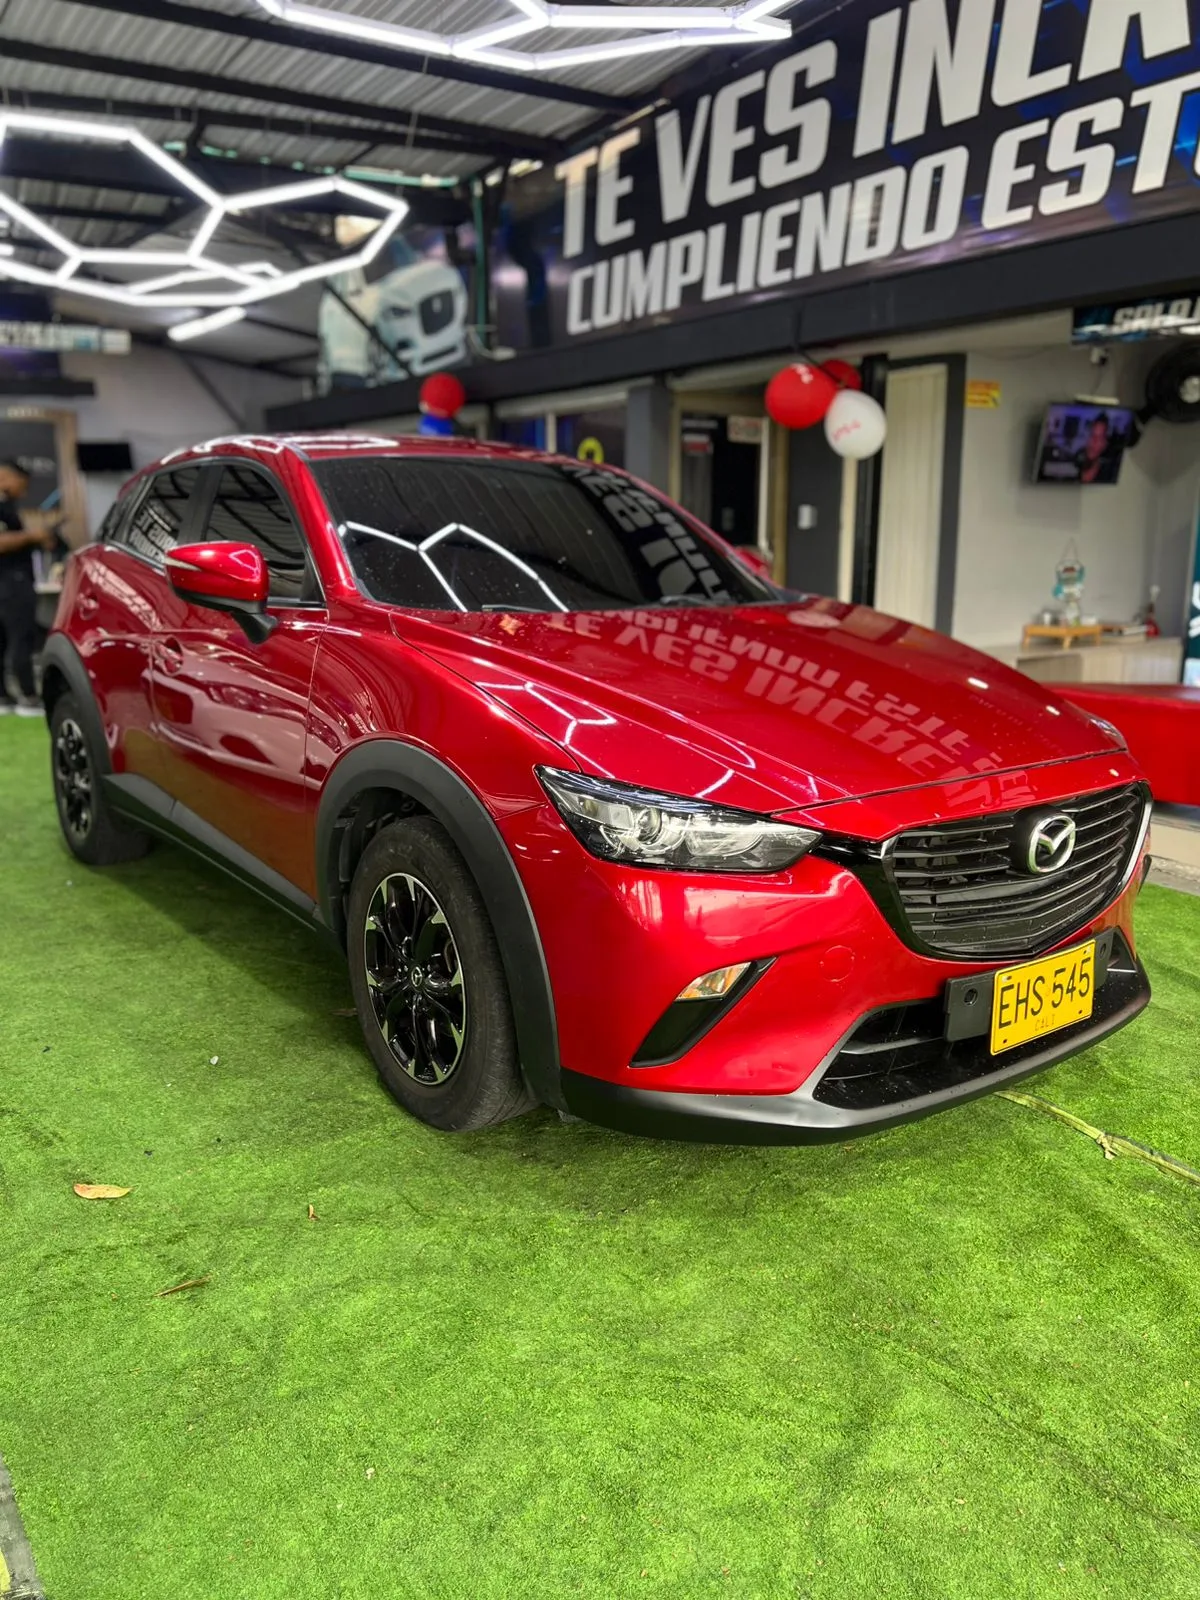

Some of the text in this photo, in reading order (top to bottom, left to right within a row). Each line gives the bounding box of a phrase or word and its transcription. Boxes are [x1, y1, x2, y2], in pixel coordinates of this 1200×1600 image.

[555, 127, 641, 259] TE
[655, 39, 838, 225] VES
[566, 72, 1200, 335] CUMPLIENDO EST
[998, 957, 1092, 1030] EHS 545
[1034, 1014, 1056, 1032] CALI
